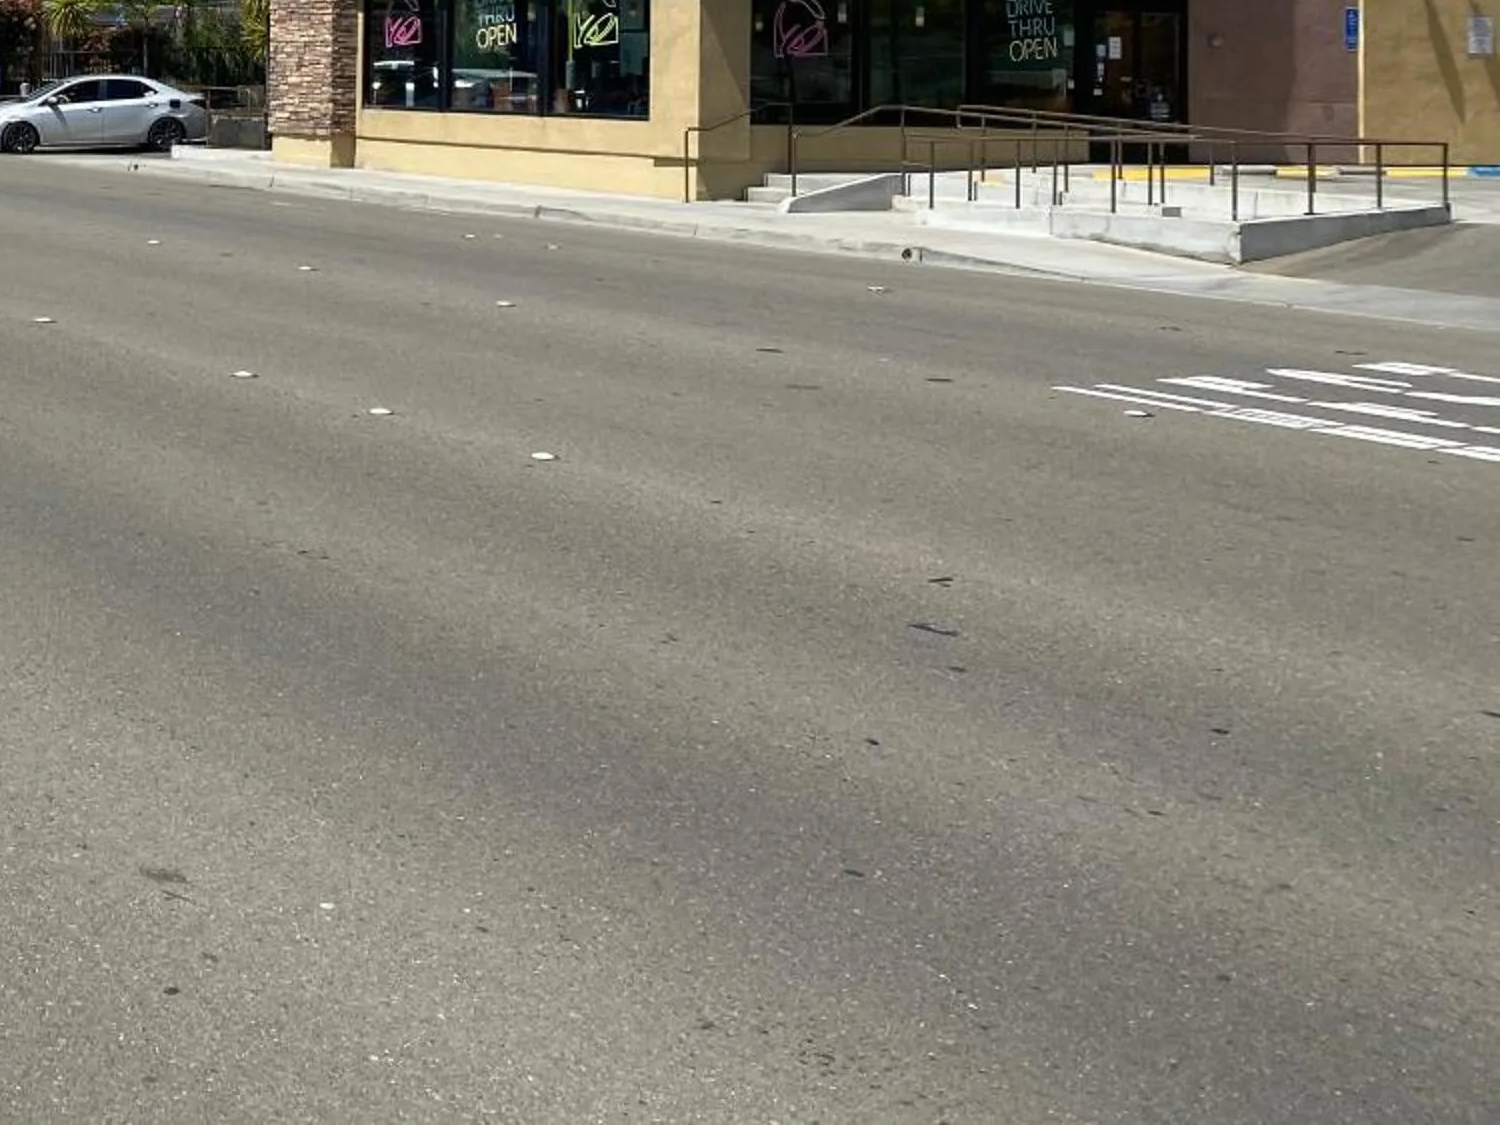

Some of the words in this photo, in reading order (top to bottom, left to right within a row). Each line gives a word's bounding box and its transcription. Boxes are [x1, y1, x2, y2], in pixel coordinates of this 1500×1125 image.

[476, 22, 517, 49] OPEN
[1008, 15, 1055, 38] THRU
[1009, 36, 1058, 62] OPEN
